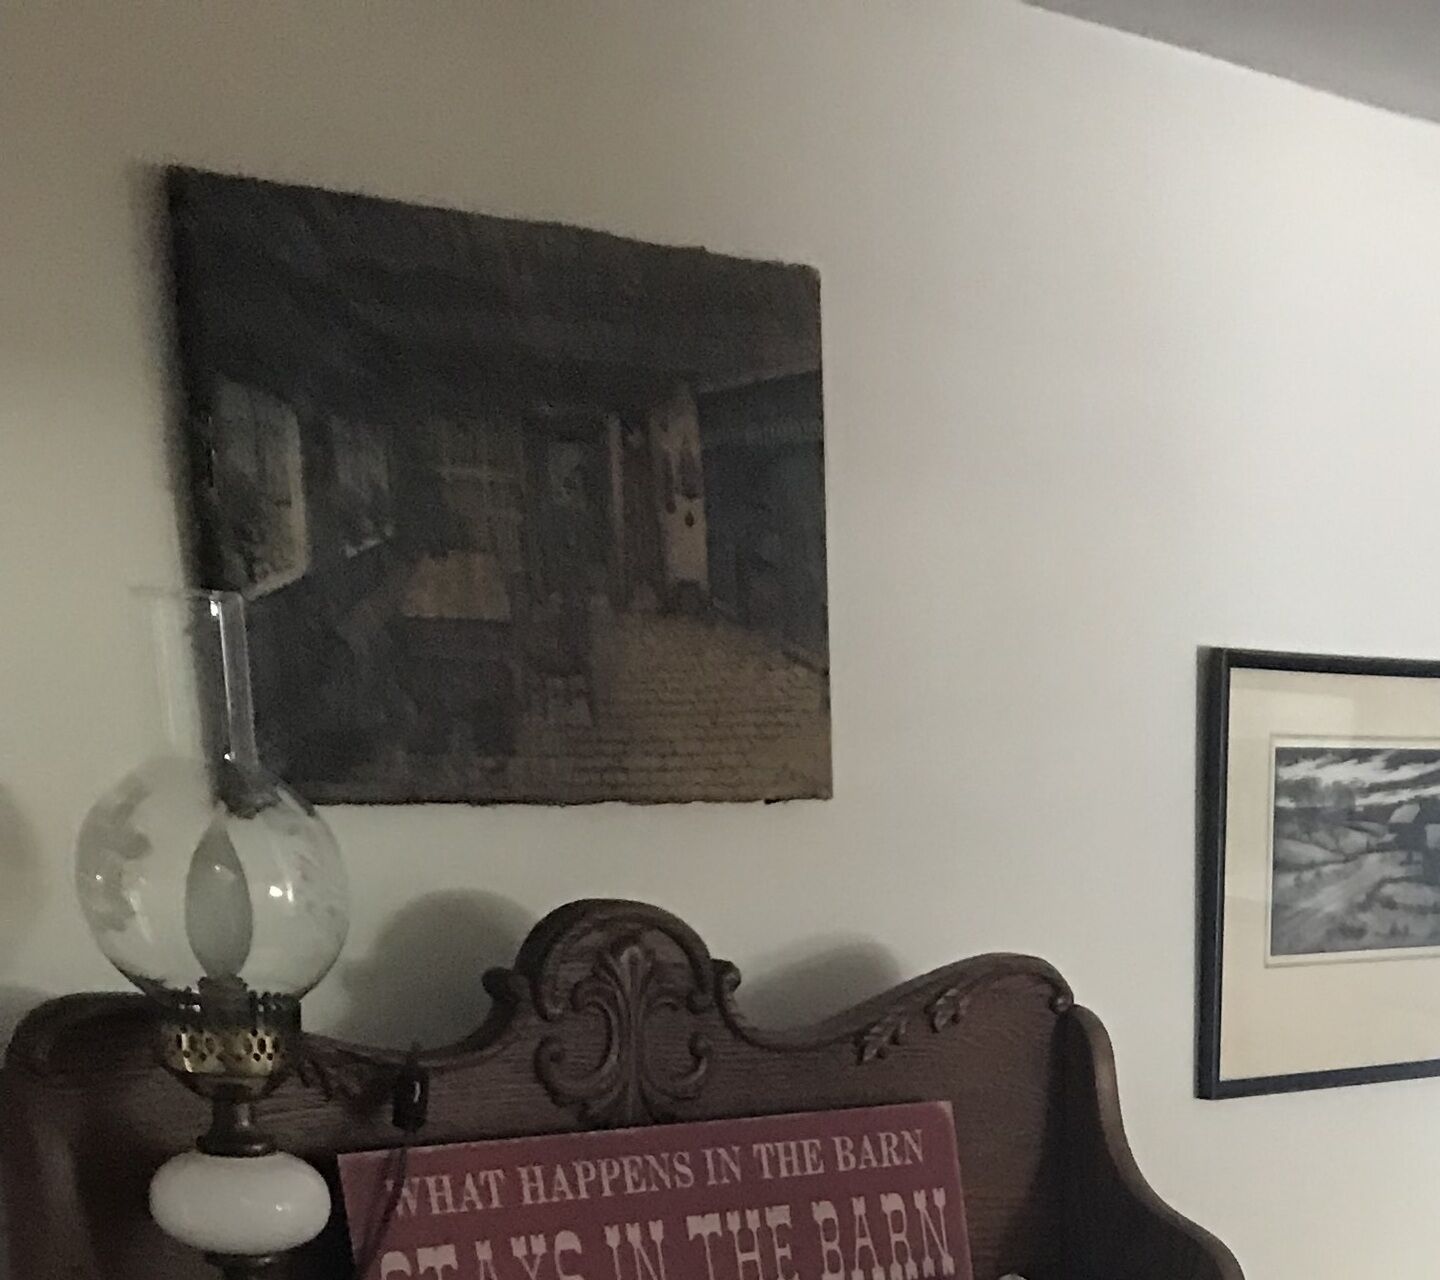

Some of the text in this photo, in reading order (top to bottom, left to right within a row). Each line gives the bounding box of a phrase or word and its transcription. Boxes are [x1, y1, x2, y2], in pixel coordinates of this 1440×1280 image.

[386, 1128, 925, 1216] WHAT HAPPENS IN THE BARN
